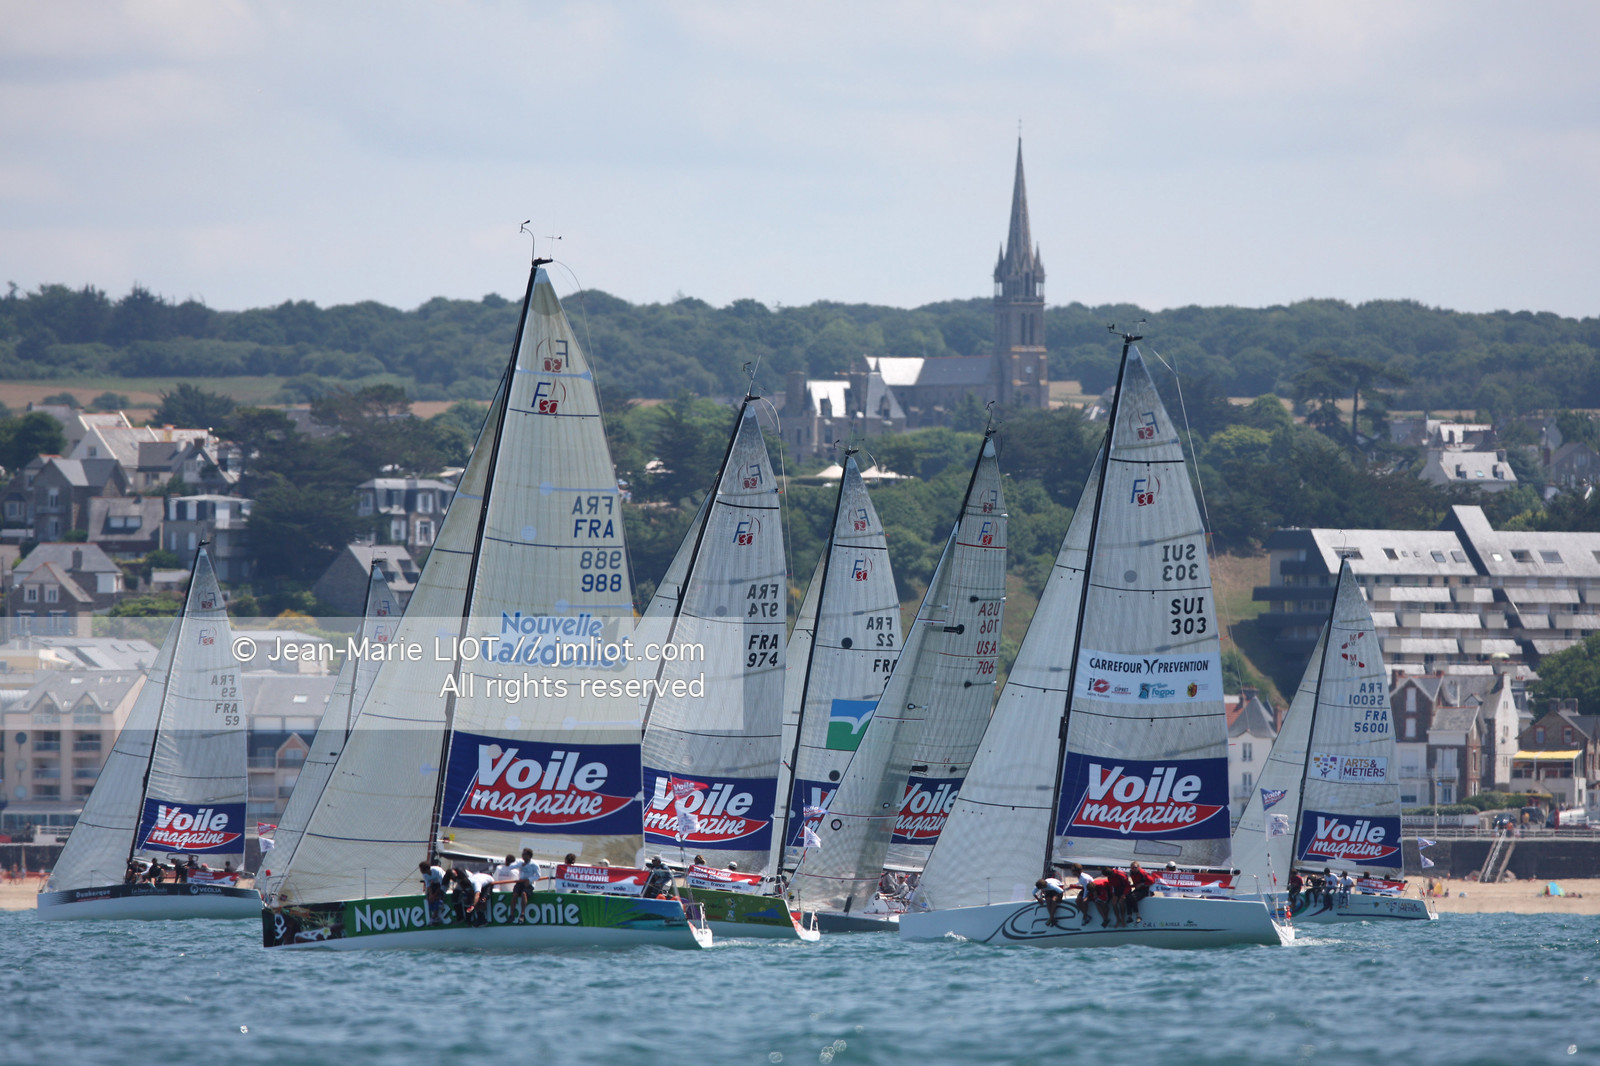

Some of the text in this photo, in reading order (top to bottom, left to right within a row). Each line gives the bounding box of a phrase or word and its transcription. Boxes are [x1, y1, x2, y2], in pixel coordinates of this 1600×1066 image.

[573, 519, 614, 538] FRA
[581, 573, 622, 592] 988
[1170, 596, 1205, 615] SUI
[501, 611, 603, 636] Nouvelle
[1170, 617, 1207, 635] 303
[748, 634, 779, 650] FRA
[976, 641, 997, 655] USA
[747, 652, 778, 668] 974
[977, 661, 994, 675] 706
[1089, 657, 1209, 673] CARREFOUR PREVENTION
[215, 703, 238, 714] FRA
[1365, 710, 1388, 721] FRA
[225, 715, 240, 726] 59
[1354, 722, 1389, 733] 56001
[478, 744, 608, 791] Voile
[1343, 767, 1385, 777] METIERS
[1344, 758, 1370, 768] ARTS
[1088, 763, 1201, 803] Voile
[652, 776, 754, 816] Voile
[470, 788, 603, 826] magazine
[157, 805, 229, 831] Voile
[1081, 802, 1197, 834] magazine
[1317, 816, 1386, 843] Voile
[152, 829, 224, 850] magazine
[1312, 840, 1382, 860] magazine
[566, 867, 609, 875] NOUVELLE
